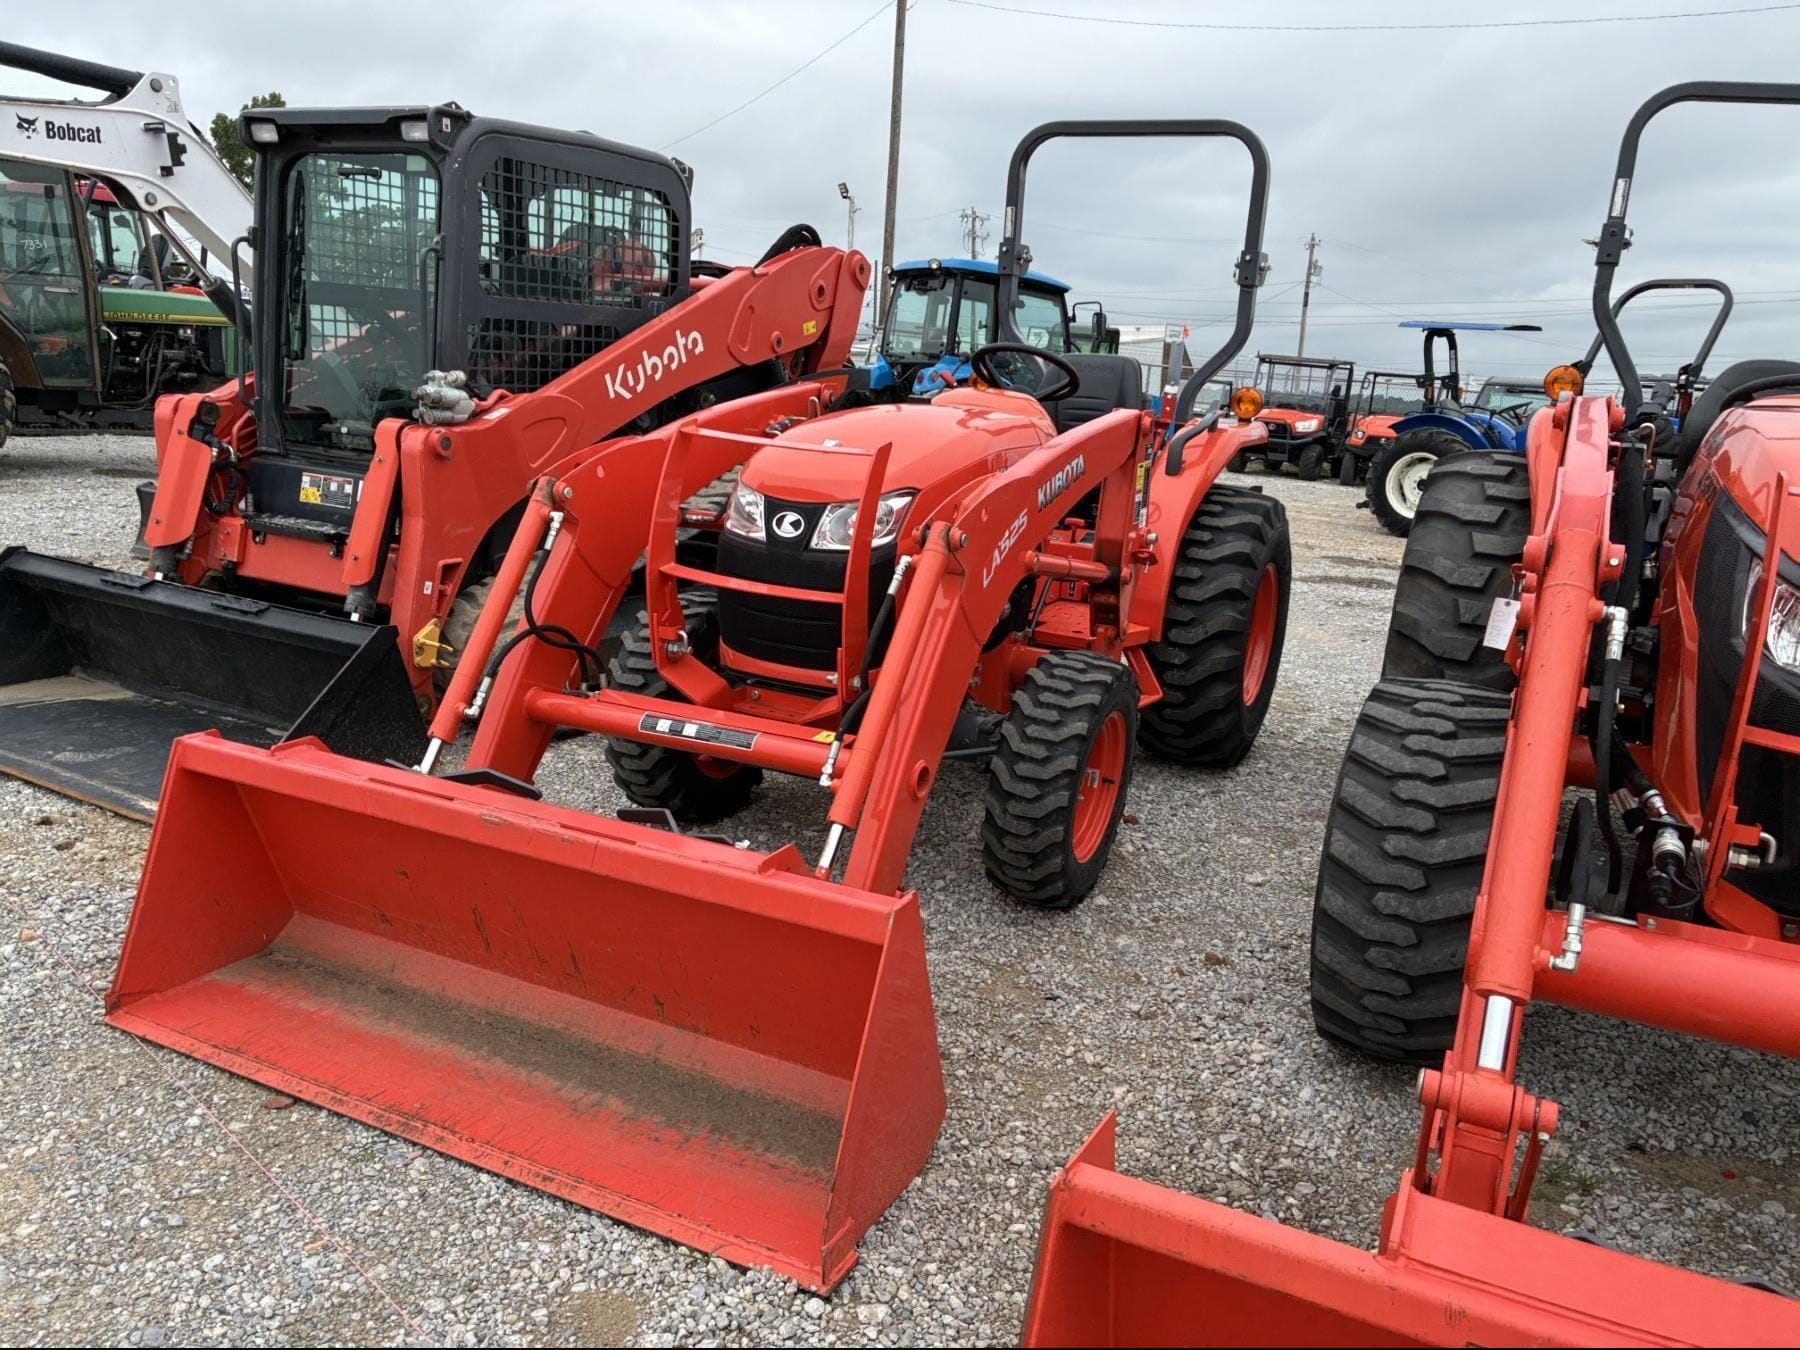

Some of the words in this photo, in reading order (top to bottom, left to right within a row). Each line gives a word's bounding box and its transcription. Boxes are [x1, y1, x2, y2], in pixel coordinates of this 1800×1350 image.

[45, 120, 102, 144] Bobcat
[19, 239, 48, 250] 7331
[604, 328, 705, 400] Kubota
[1037, 454, 1086, 513] KUBOTA
[983, 508, 1029, 589] LA525
